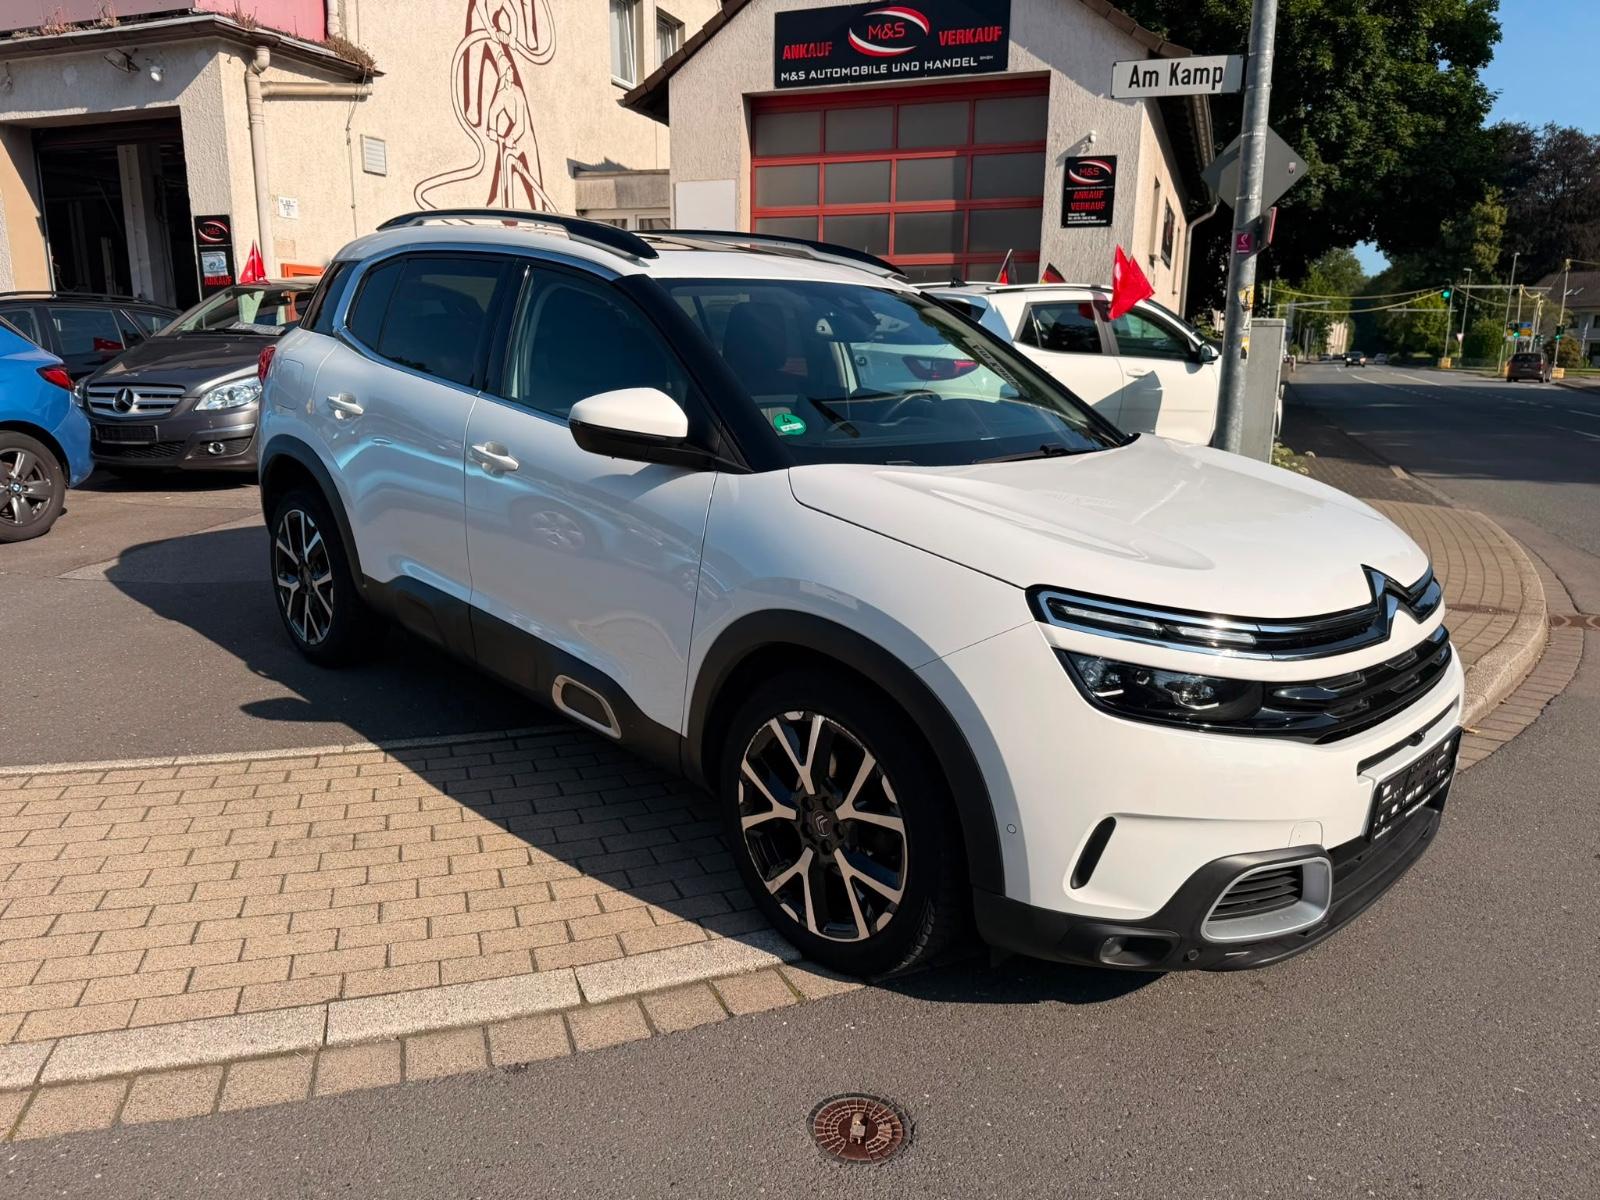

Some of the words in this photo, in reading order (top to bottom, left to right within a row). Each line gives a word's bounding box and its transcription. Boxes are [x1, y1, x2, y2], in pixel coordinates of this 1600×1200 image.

[868, 22, 905, 40] M&S
[939, 26, 1002, 46] VERKAUF
[782, 41, 833, 60] ANKAUF
[781, 71, 806, 82] M&S
[809, 64, 888, 80] AUTOMOBILE
[892, 61, 920, 73] UND
[924, 57, 978, 70] HANDEL
[1128, 64, 1160, 88] Am
[1168, 62, 1223, 90] Kamp
[1074, 190, 1104, 199] ANKAUF
[1071, 201, 1105, 210] VERKAUF
[204, 275, 232, 286] ANKAUF
